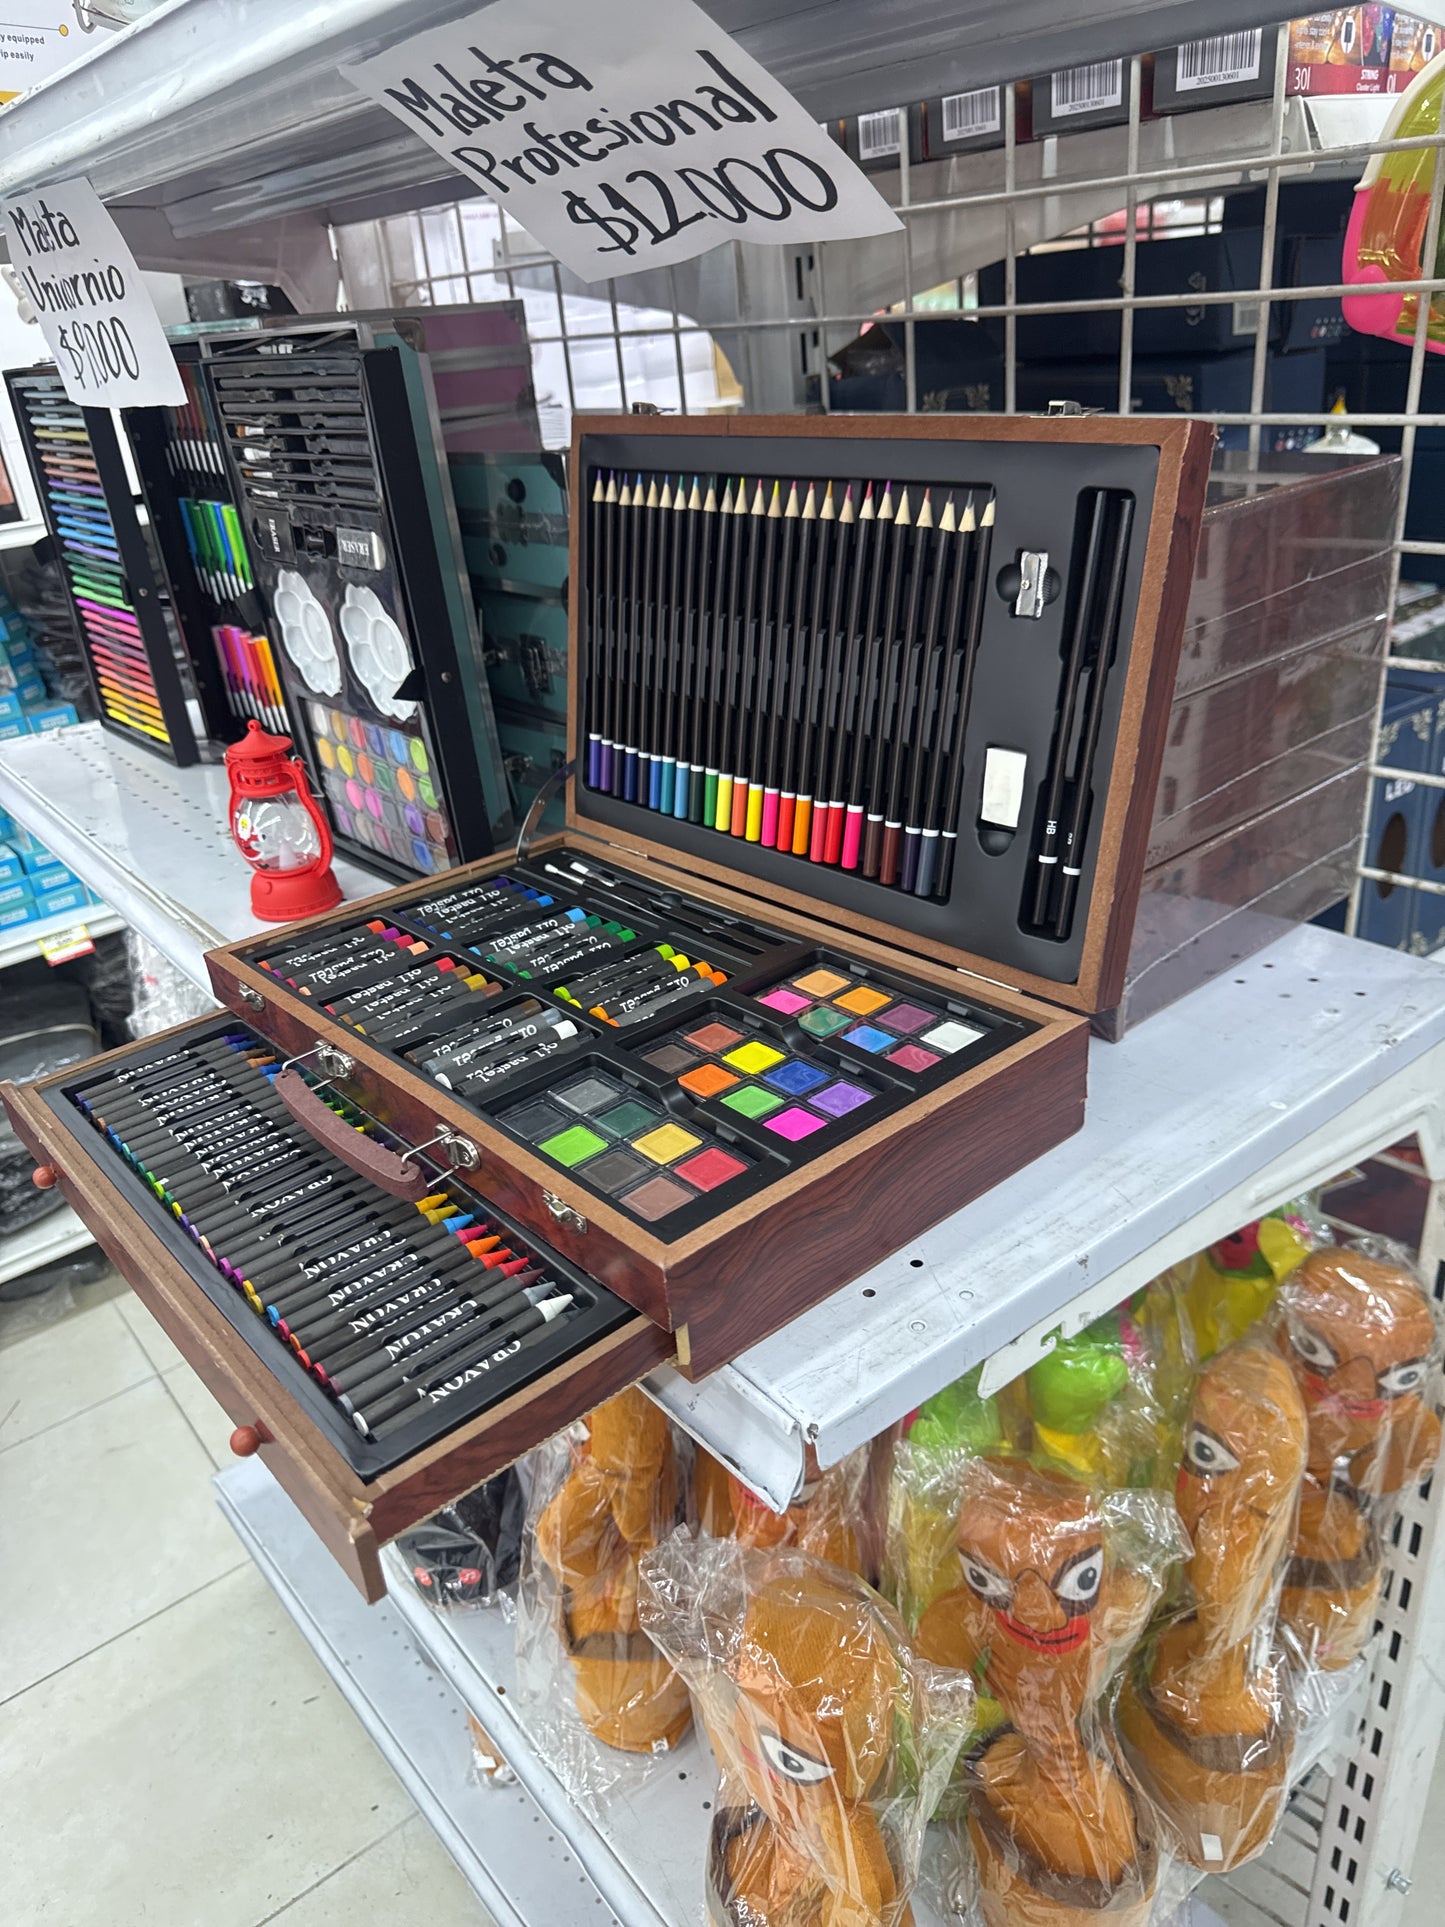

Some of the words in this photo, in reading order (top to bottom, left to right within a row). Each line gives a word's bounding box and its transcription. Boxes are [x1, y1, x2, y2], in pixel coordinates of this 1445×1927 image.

[7, 34, 45, 45] equipped
[10, 52, 34, 62] easily
[384, 46, 594, 137] Maleta
[451, 49, 778, 193] Profesional
[561, 148, 838, 255] $12.000
[341, 540, 370, 556] ERASER
[1046, 820, 1057, 835] HB
[385, 1299, 478, 1361] CRAYON
[428, 1340, 521, 1404] CRAYON
